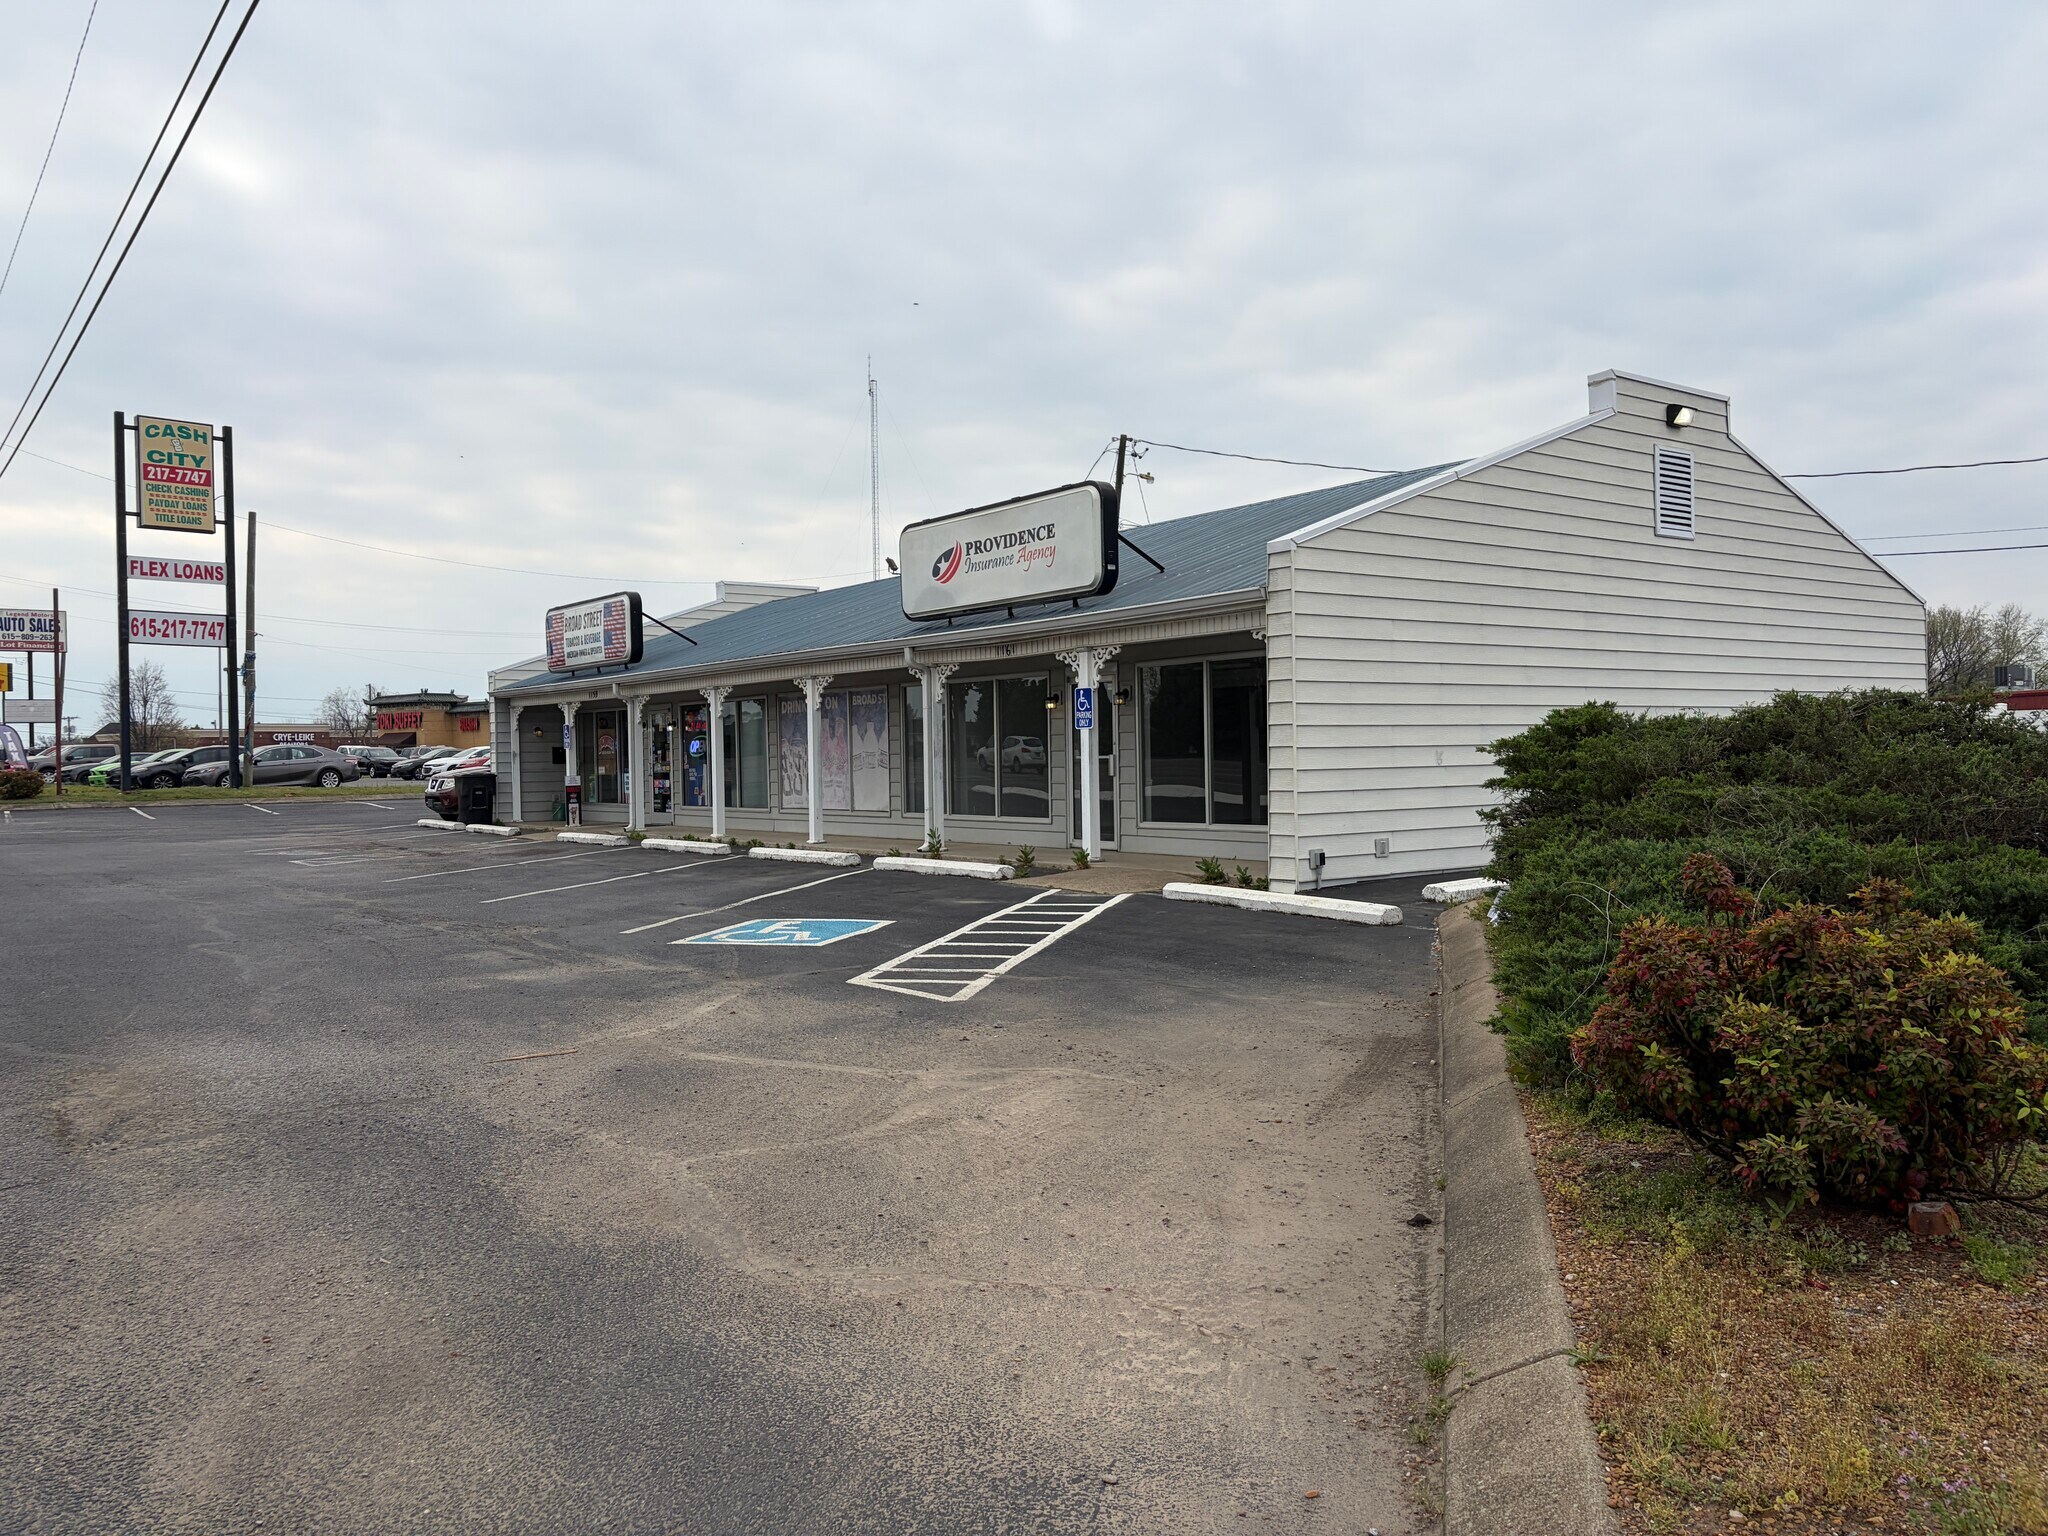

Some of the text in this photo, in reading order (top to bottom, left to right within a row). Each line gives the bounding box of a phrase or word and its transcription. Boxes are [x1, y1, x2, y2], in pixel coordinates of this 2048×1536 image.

[145, 424, 207, 445] CASH
[147, 450, 206, 468] CITY
[147, 466, 207, 484] 217-7747
[146, 483, 172, 493] CHECK
[174, 486, 209, 498] CASHING
[149, 498, 180, 509] PAYDAY
[182, 501, 208, 512] LOANS
[155, 513, 202, 526] TITLE LOANS
[965, 523, 1056, 556] PROVIDENCE
[965, 545, 1056, 573] Insurance Agency
[130, 560, 224, 581] FLEX LOANS
[131, 617, 224, 640] 615-217-7747
[583, 610, 602, 630] STREET
[2, 633, 55, 641] 615-809-263
[997, 644, 1015, 657] 1161
[825, 697, 838, 709] ON
[852, 694, 876, 706] BROAD
[878, 693, 886, 704] ST
[394, 711, 421, 729] BUFFET
[1076, 711, 1092, 719] PARKING
[1079, 719, 1090, 727] ONLY
[273, 733, 315, 741] CRYE-LEIKE
[3, 731, 21, 762] TAX
